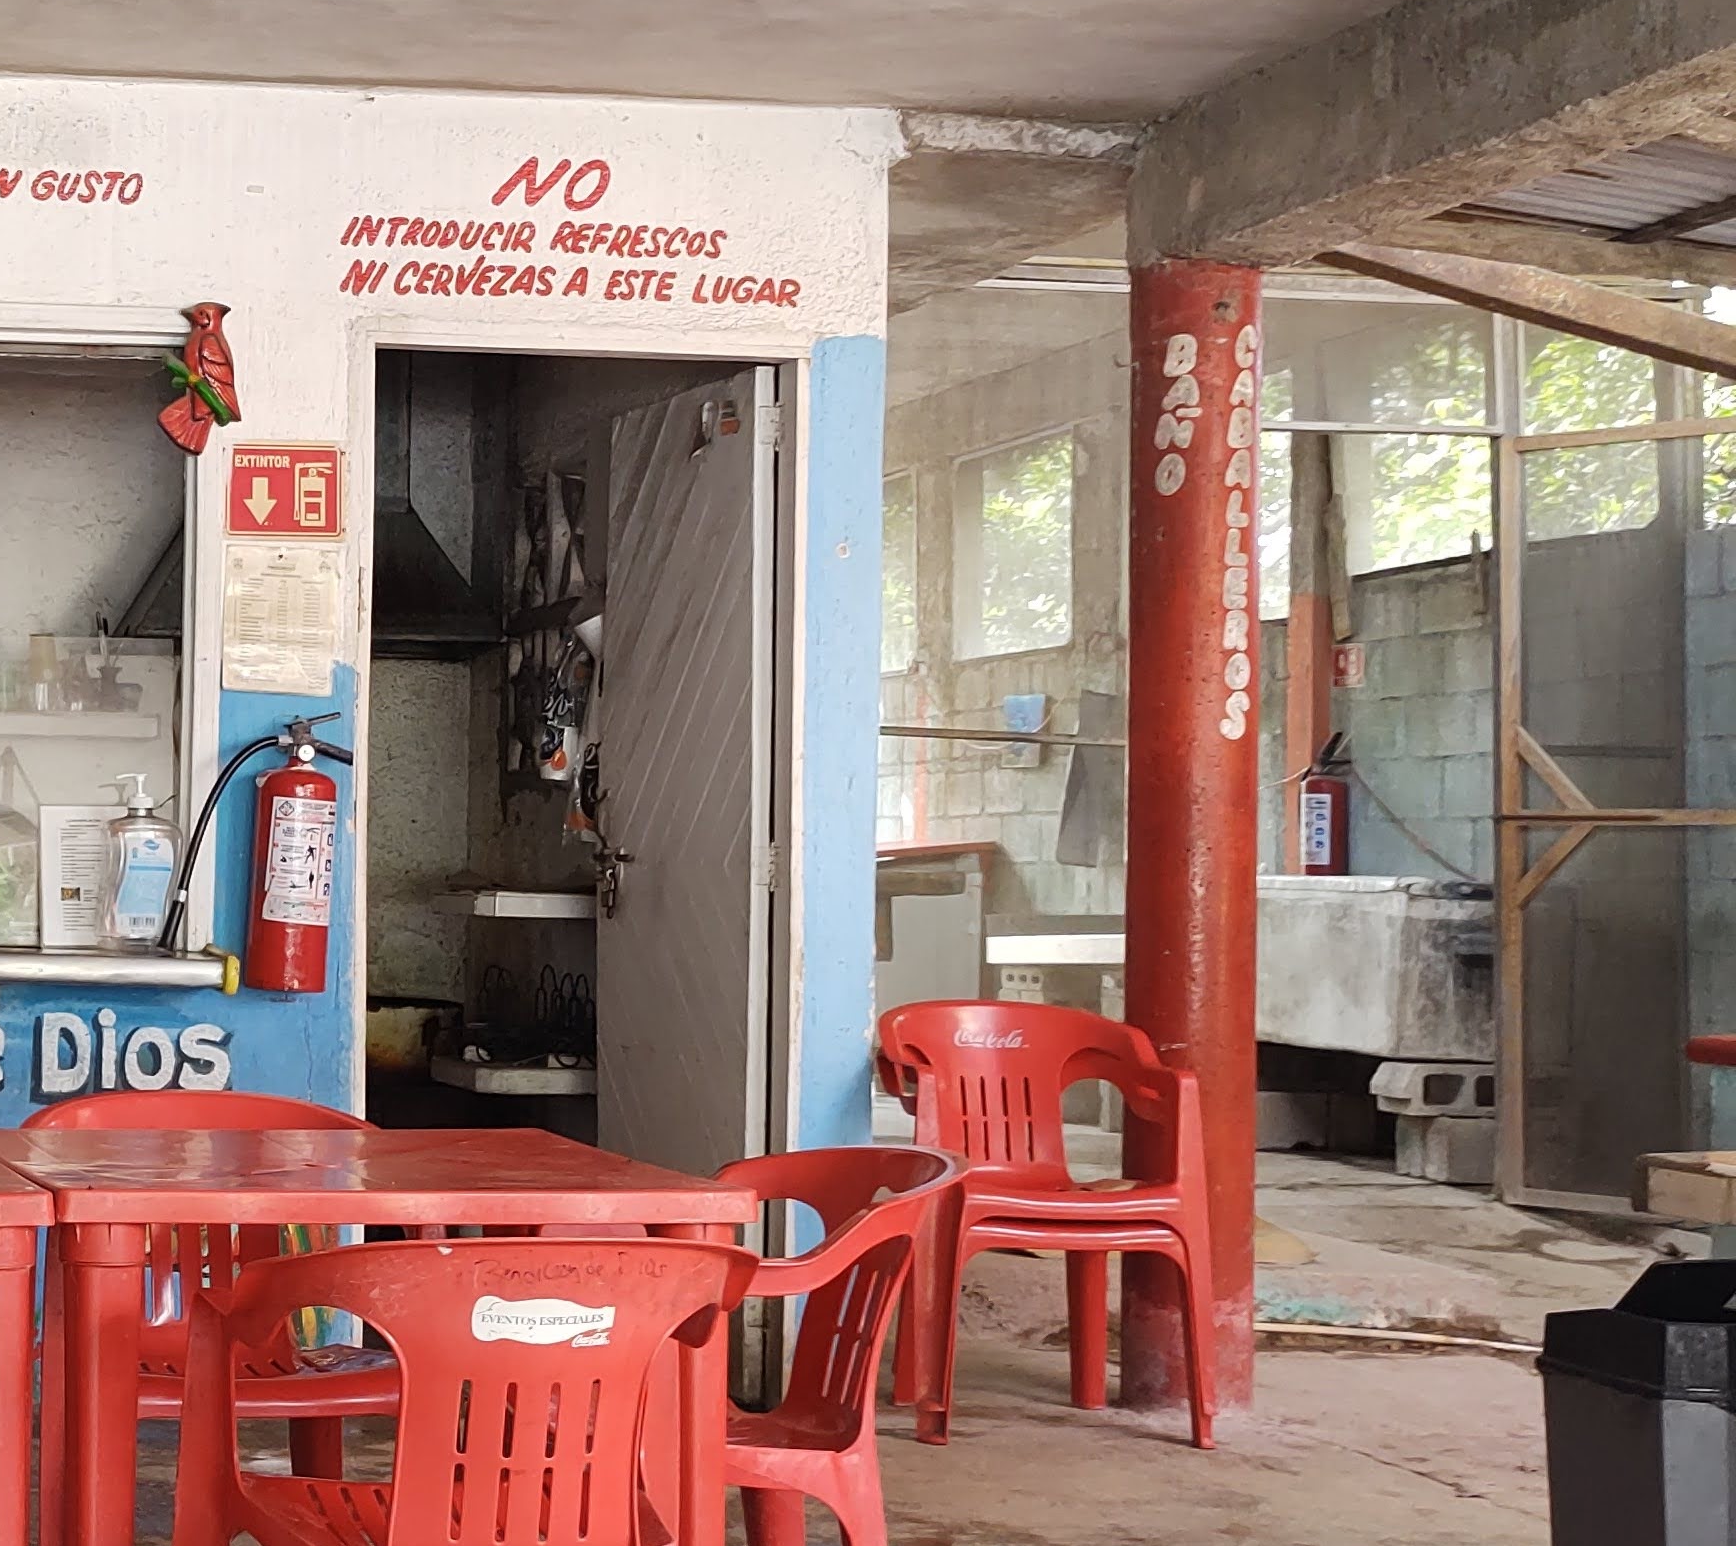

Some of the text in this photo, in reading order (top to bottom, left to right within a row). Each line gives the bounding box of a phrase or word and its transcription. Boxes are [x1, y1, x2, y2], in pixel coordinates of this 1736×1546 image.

[31, 170, 143, 205] GUSTO
[491, 156, 611, 212] NO
[340, 216, 727, 259] INTRODUCIR REFRESCOS
[340, 255, 802, 308] NI CERVEZAS A ESTE LUGAR
[1155, 333, 1202, 497] BAÑO
[234, 454, 291, 469] EXTINTOR
[1220, 324, 1257, 741] CABALLEROS
[40, 1007, 232, 1093] Dios
[480, 1313, 605, 1326] EVENTOS ESPECIALES
